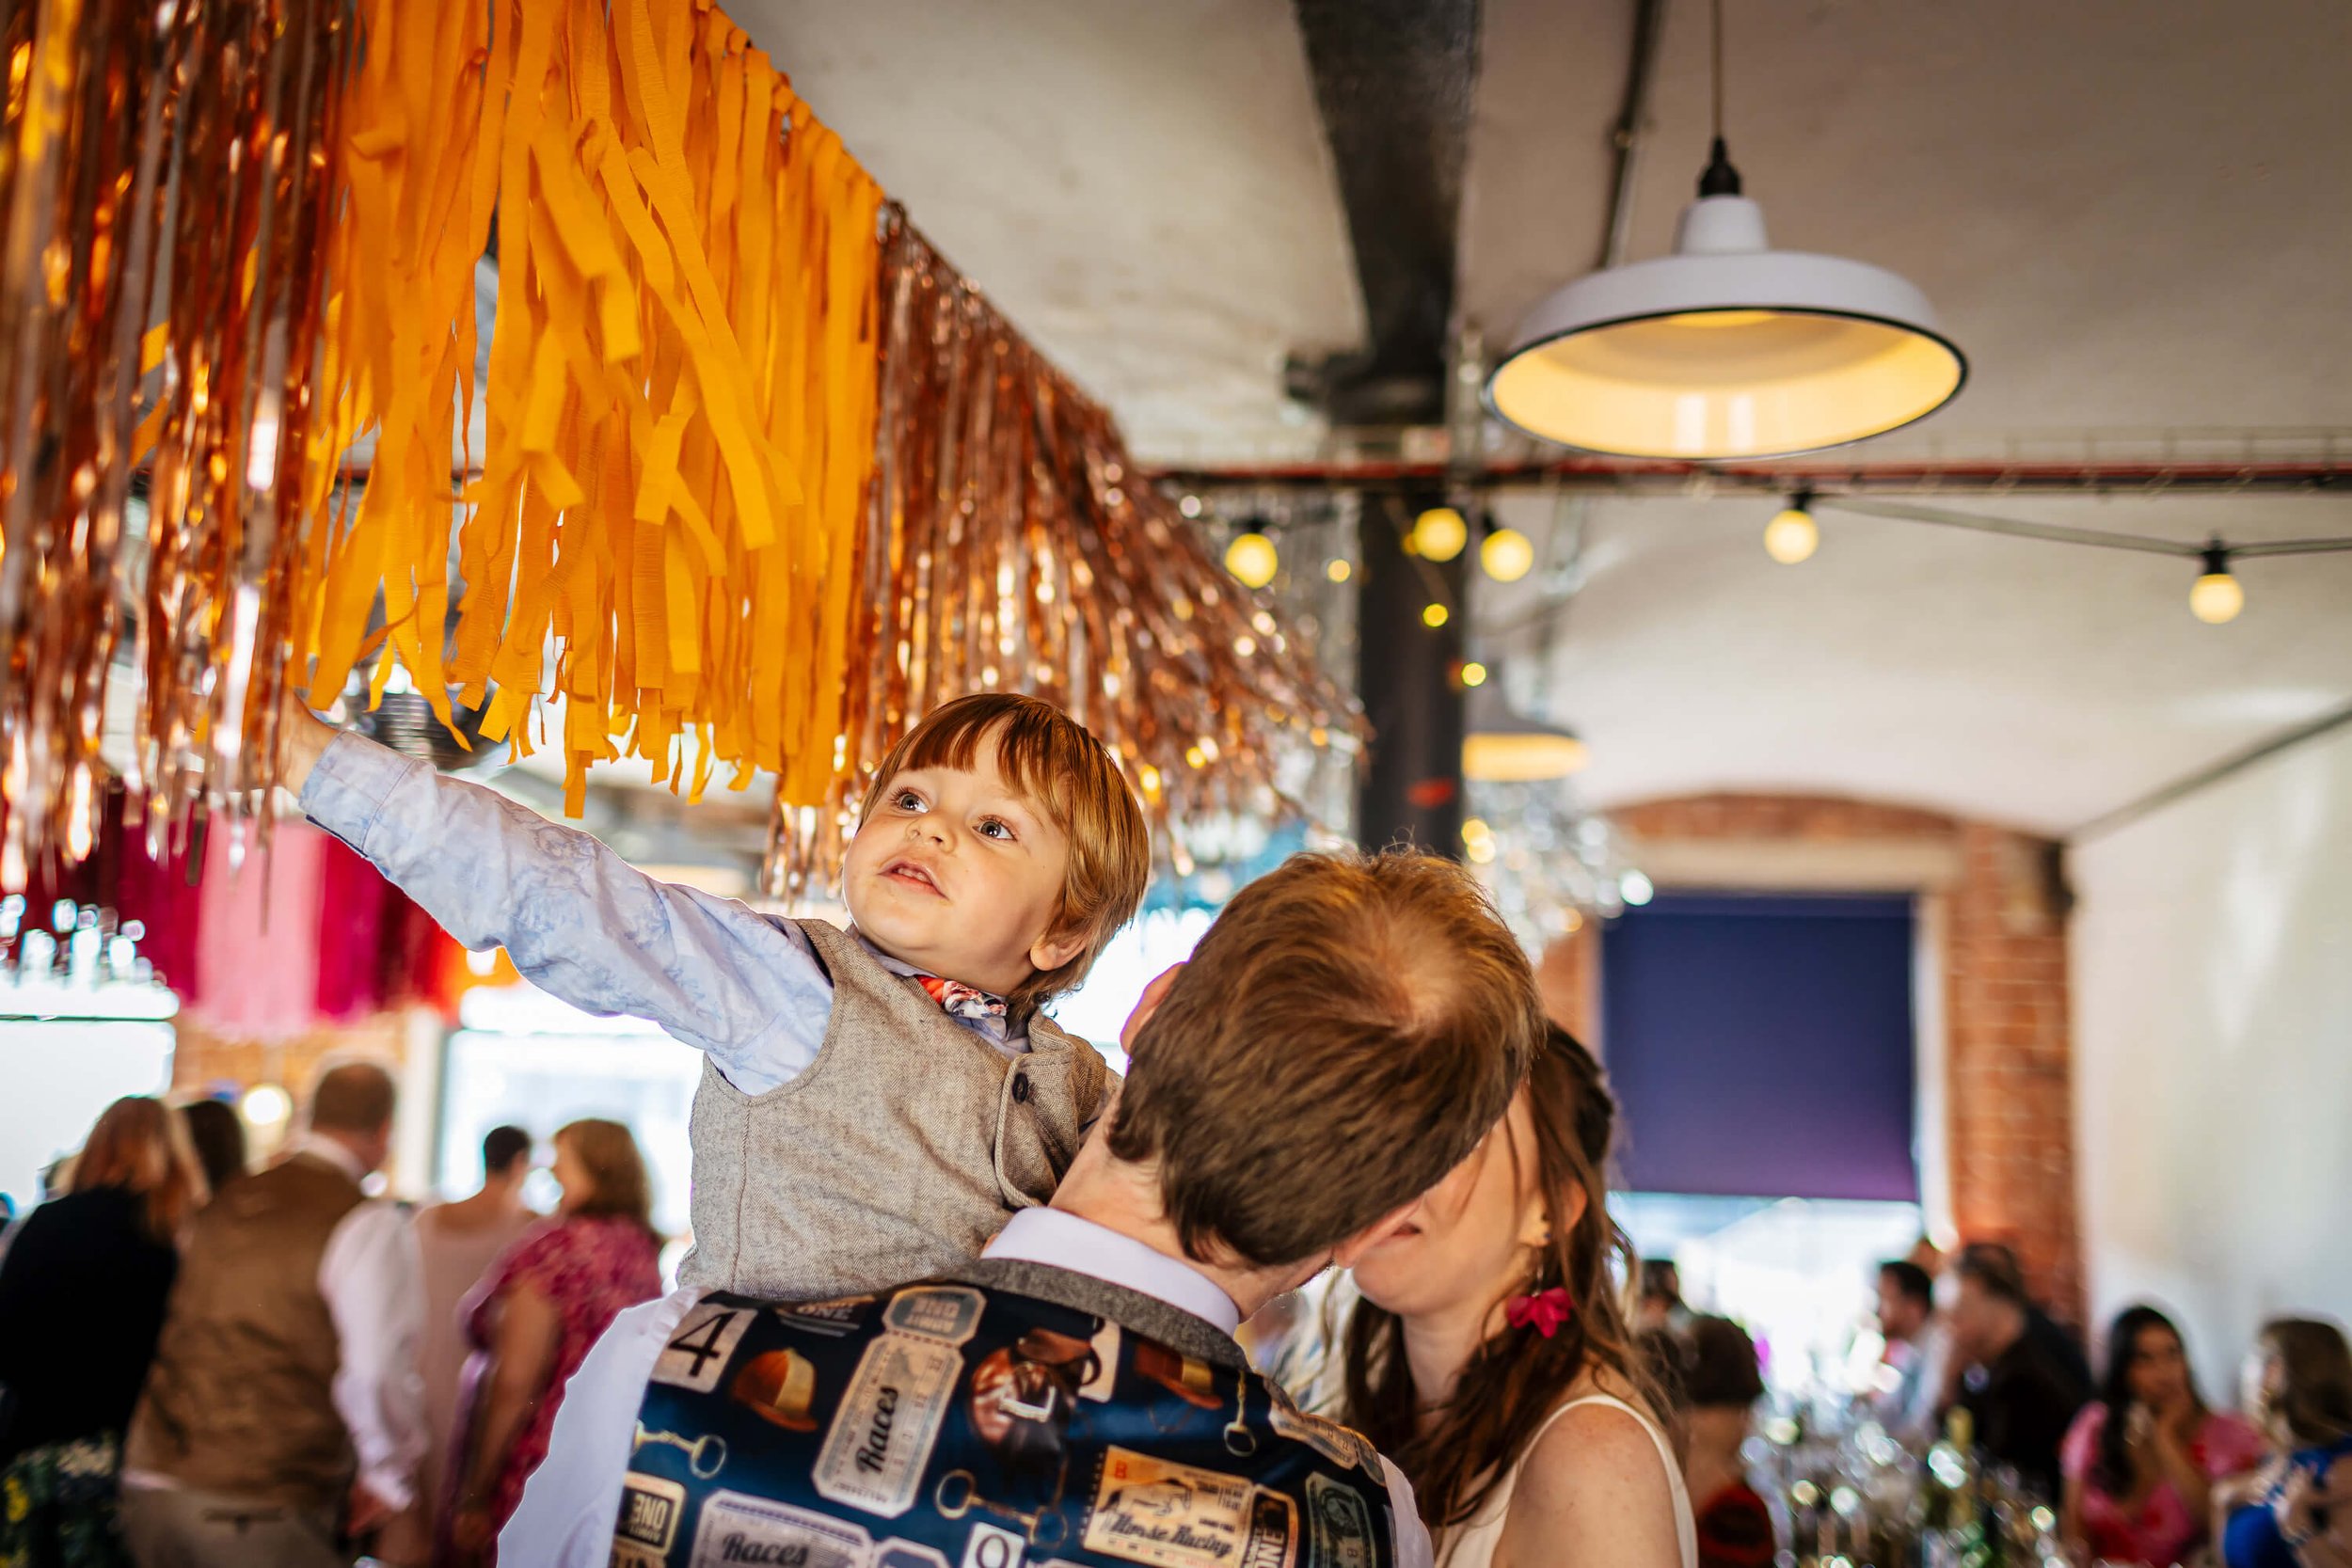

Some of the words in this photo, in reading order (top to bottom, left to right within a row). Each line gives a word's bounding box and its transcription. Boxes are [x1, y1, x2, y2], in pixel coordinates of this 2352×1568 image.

[666, 1310, 739, 1377] 4
[853, 1386, 898, 1474] Races
[631, 1494, 669, 1530] ONE
[723, 1532, 811, 1568] Races
[1110, 1513, 1168, 1541] Horse
[1169, 1524, 1233, 1560] Racing
